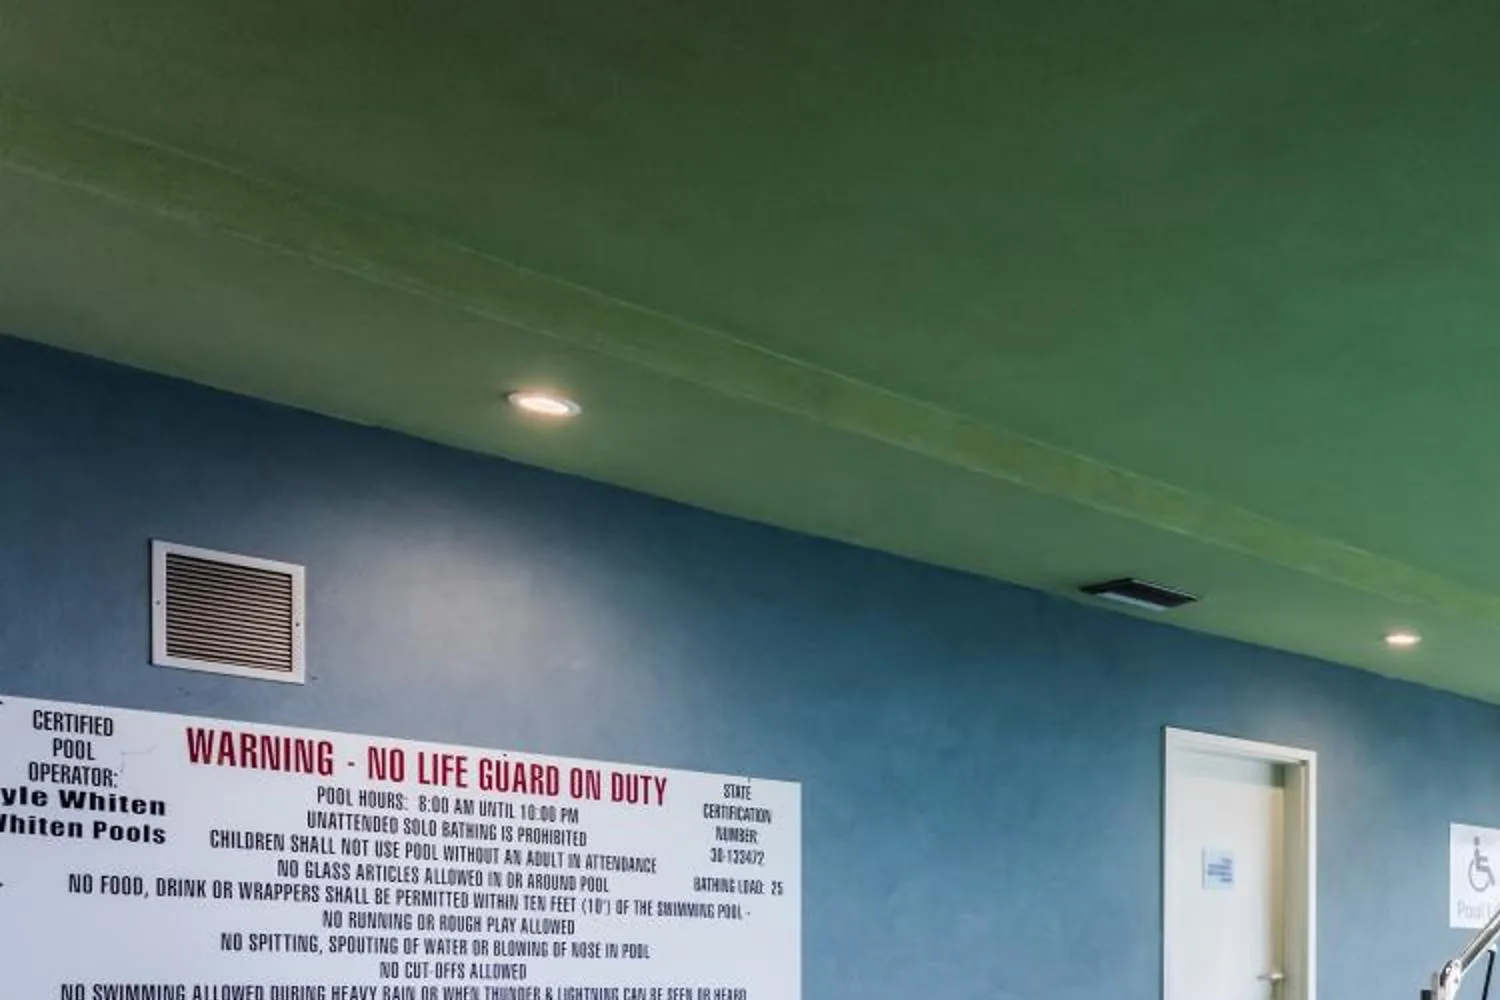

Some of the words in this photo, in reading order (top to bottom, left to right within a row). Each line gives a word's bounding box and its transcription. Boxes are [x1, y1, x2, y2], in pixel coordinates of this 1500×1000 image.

[33, 710, 113, 736] CERTIFIED
[53, 738, 96, 760] POOL
[29, 762, 118, 788] OPERATOR:
[186, 727, 333, 775] WARNING
[368, 746, 404, 782] NO
[418, 752, 468, 788] LIFE
[479, 757, 559, 796] GUARD
[570, 767, 601, 801] ON
[610, 773, 667, 806] DUTY
[0, 786, 48, 806] yle
[59, 789, 165, 816] Whiten
[317, 785, 353, 807] POOL
[359, 790, 409, 811] HOURS:
[419, 797, 449, 813] 8:00
[454, 799, 474, 815] AM
[480, 801, 515, 820] UNTIL
[521, 804, 557, 822] 10:00
[561, 807, 579, 824] PM
[723, 783, 751, 800] STATE
[703, 804, 772, 824] CERTIFICATION
[0, 814, 82, 838] hiten
[94, 821, 166, 844] Pools
[307, 811, 398, 834] UNATTENDED
[403, 818, 437, 837] SOLO
[442, 821, 497, 841] BATHING
[501, 826, 513, 842] IS
[518, 828, 587, 847] PROHIBITED
[210, 829, 284, 851] CHILDREN
[291, 833, 336, 855] SHALL
[341, 838, 368, 856] NOT
[375, 840, 400, 858] USE
[405, 842, 439, 861] POOL
[443, 846, 499, 864] WITHOUT
[504, 850, 521, 865] AN
[526, 851, 564, 868] ADULT
[568, 854, 581, 868] IN
[586, 854, 657, 874] ATTENDANCE
[278, 859, 299, 878] NO
[305, 861, 350, 880] GLASS
[356, 864, 419, 884] ARTICLES
[425, 868, 482, 887] ALLOWED
[488, 871, 501, 887] IN
[507, 872, 523, 889] OR
[527, 873, 576, 891] AROUND
[580, 876, 609, 893] POOL
[694, 876, 735, 893] BATHING
[771, 880, 783, 895] 25
[69, 873, 92, 894] NO
[101, 875, 149, 898] FOOD,
[156, 877, 207, 898] DRINK
[213, 880, 233, 899] OR
[239, 882, 319, 903] WRAPPERS
[325, 885, 369, 905] SHALL
[375, 888, 390, 905] BE
[396, 889, 468, 908] PERMITTED
[473, 892, 518, 910] WITHIN
[525, 895, 546, 911] TEN
[551, 897, 576, 913] FEET
[616, 900, 629, 915] OF
[634, 900, 652, 916] THE
[657, 901, 714, 919] SWIMMING
[718, 903, 742, 920] POOL
[322, 910, 342, 928] NO
[349, 911, 412, 930] RUNNING
[418, 914, 435, 931] OR
[439, 915, 481, 932] ROUGH
[487, 917, 516, 933] PLAY
[521, 916, 575, 935] ALLOWED
[221, 932, 242, 951] NO
[248, 933, 323, 955] SPITTING,
[329, 936, 399, 954] SPOUTING
[403, 937, 419, 954] OF
[424, 938, 468, 955] WATER
[472, 940, 489, 956] OR
[494, 939, 549, 959] BLOWING
[553, 942, 566, 958] OF
[572, 942, 601, 958] NOSE
[605, 943, 618, 959] IN
[622, 943, 650, 959] POOL
[380, 961, 399, 979] NO
[469, 963, 526, 980] ALLOWED
